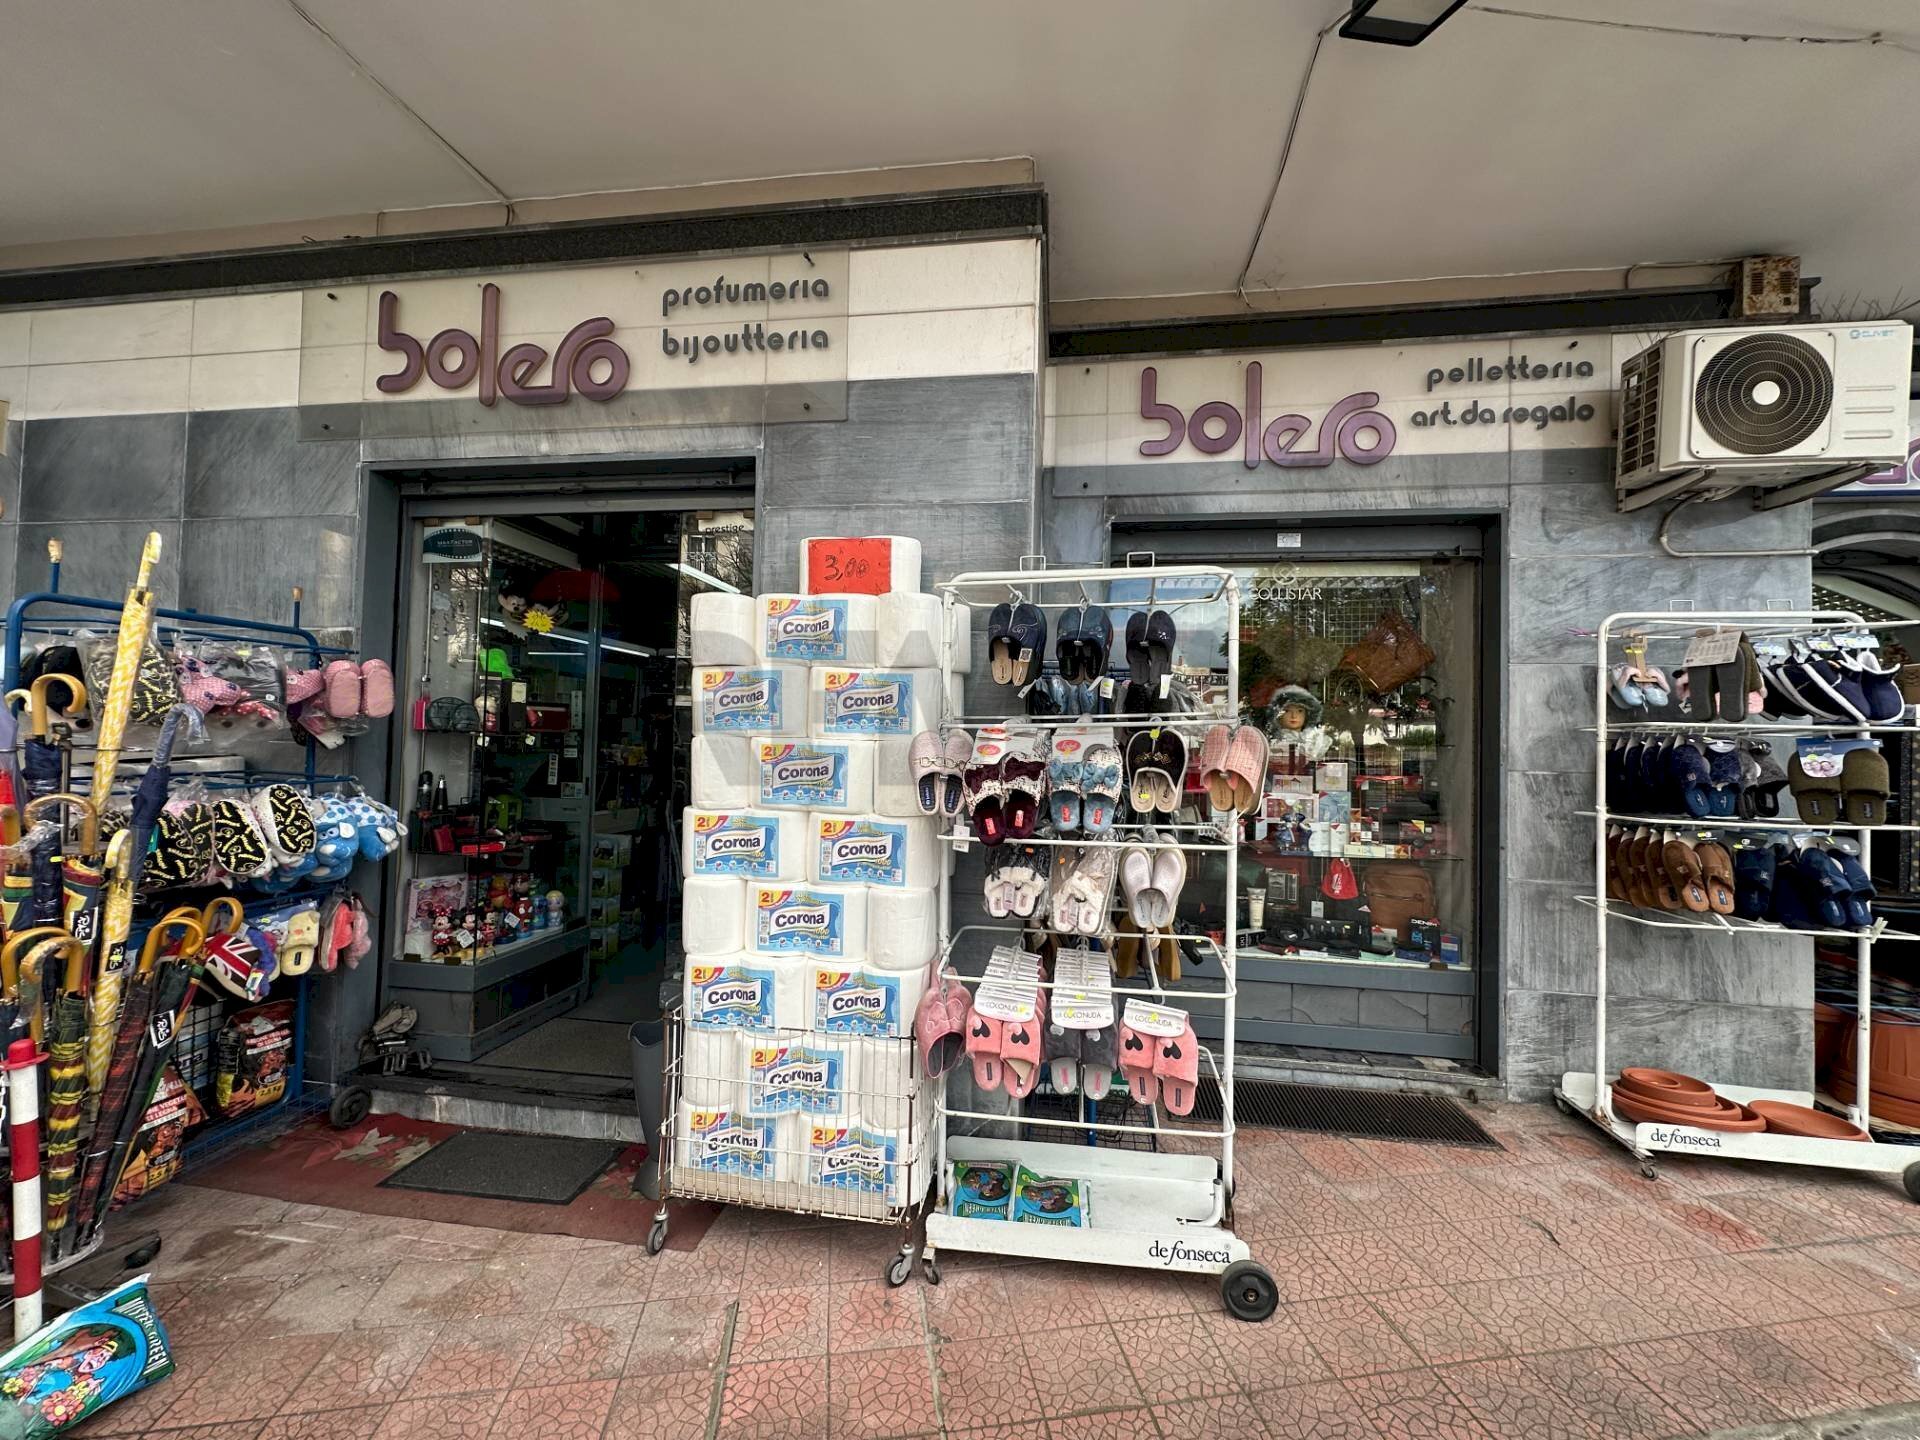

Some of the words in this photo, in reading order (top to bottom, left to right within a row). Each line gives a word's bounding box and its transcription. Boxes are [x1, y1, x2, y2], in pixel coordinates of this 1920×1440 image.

[662, 275, 829, 316] profumeria
[376, 283, 631, 407] bolero
[662, 323, 829, 364] bijoutteria
[1427, 355, 1594, 392] pelletteria
[1140, 361, 1397, 469] bolero
[1503, 396, 1595, 430] regalo
[705, 524, 745, 534] prestige
[770, 600, 778, 611] 2
[783, 619, 829, 635] Corona
[705, 674, 713, 684] 2
[828, 674, 836, 685] 2
[842, 693, 893, 709] Corona
[764, 746, 772, 757] 2
[777, 765, 829, 780] Corona
[697, 817, 706, 827] 2
[824, 822, 832, 833] 2
[711, 836, 761, 851] Corona
[837, 844, 887, 858] Corona
[761, 892, 769, 902] 2
[774, 913, 825, 927] Corona
[694, 968, 702, 979] 2
[819, 973, 827, 984] 2
[707, 989, 756, 1004] Corona
[755, 1051, 764, 1062] 2
[769, 1069, 823, 1087] Corona
[696, 1114, 703, 1125] 2
[814, 1129, 823, 1140] 2
[142, 1330, 170, 1375] GREEN
